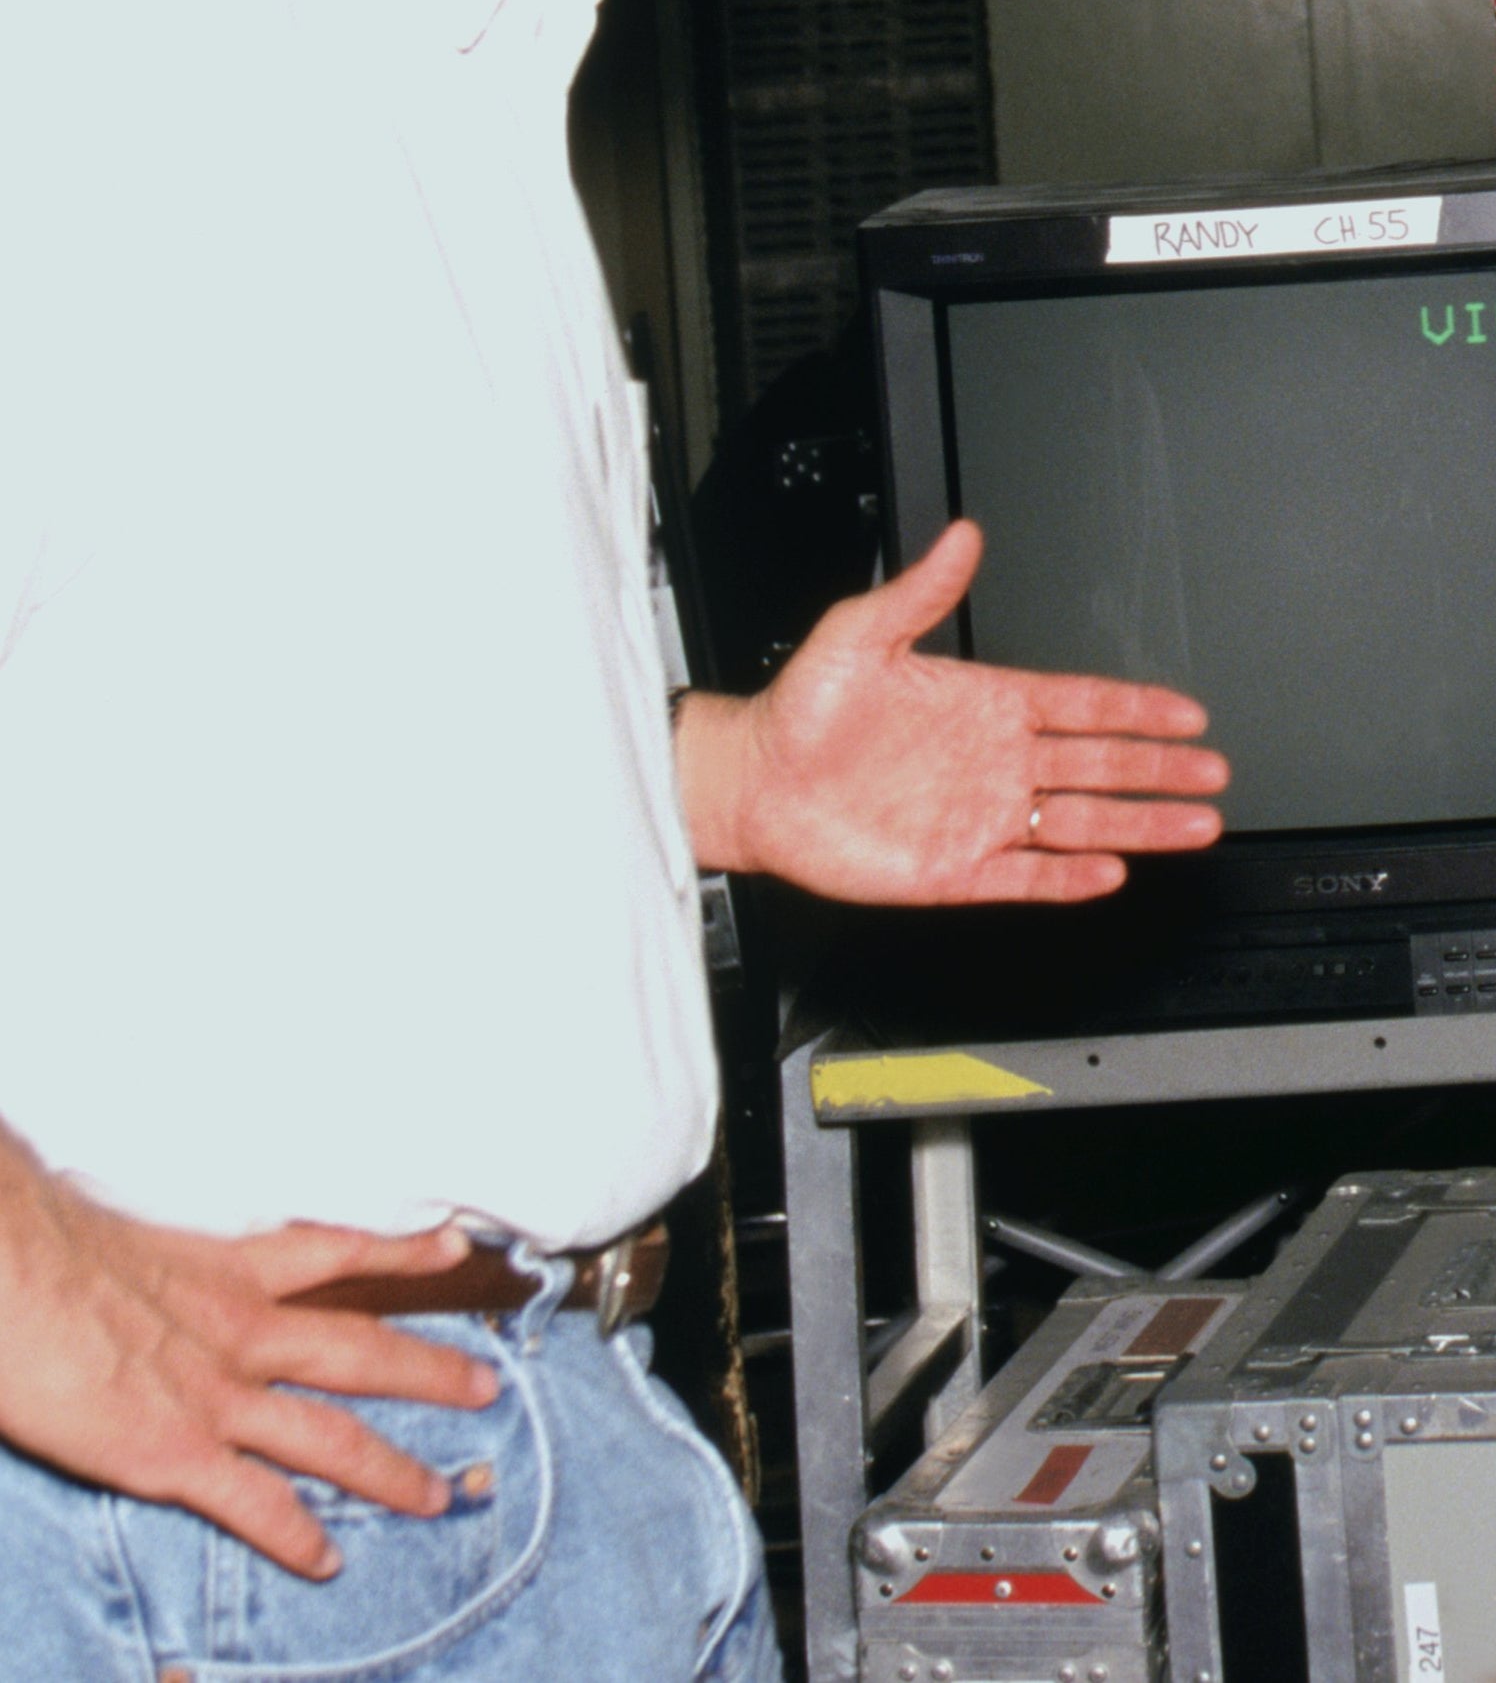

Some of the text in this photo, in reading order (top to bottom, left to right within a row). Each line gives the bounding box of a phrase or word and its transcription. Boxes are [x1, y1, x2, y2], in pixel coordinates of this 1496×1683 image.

[1153, 220, 1259, 257] RANDY
[1368, 209, 1410, 240] 55
[1293, 872, 1388, 894] SONY
[1416, 1626, 1443, 1673] 247
